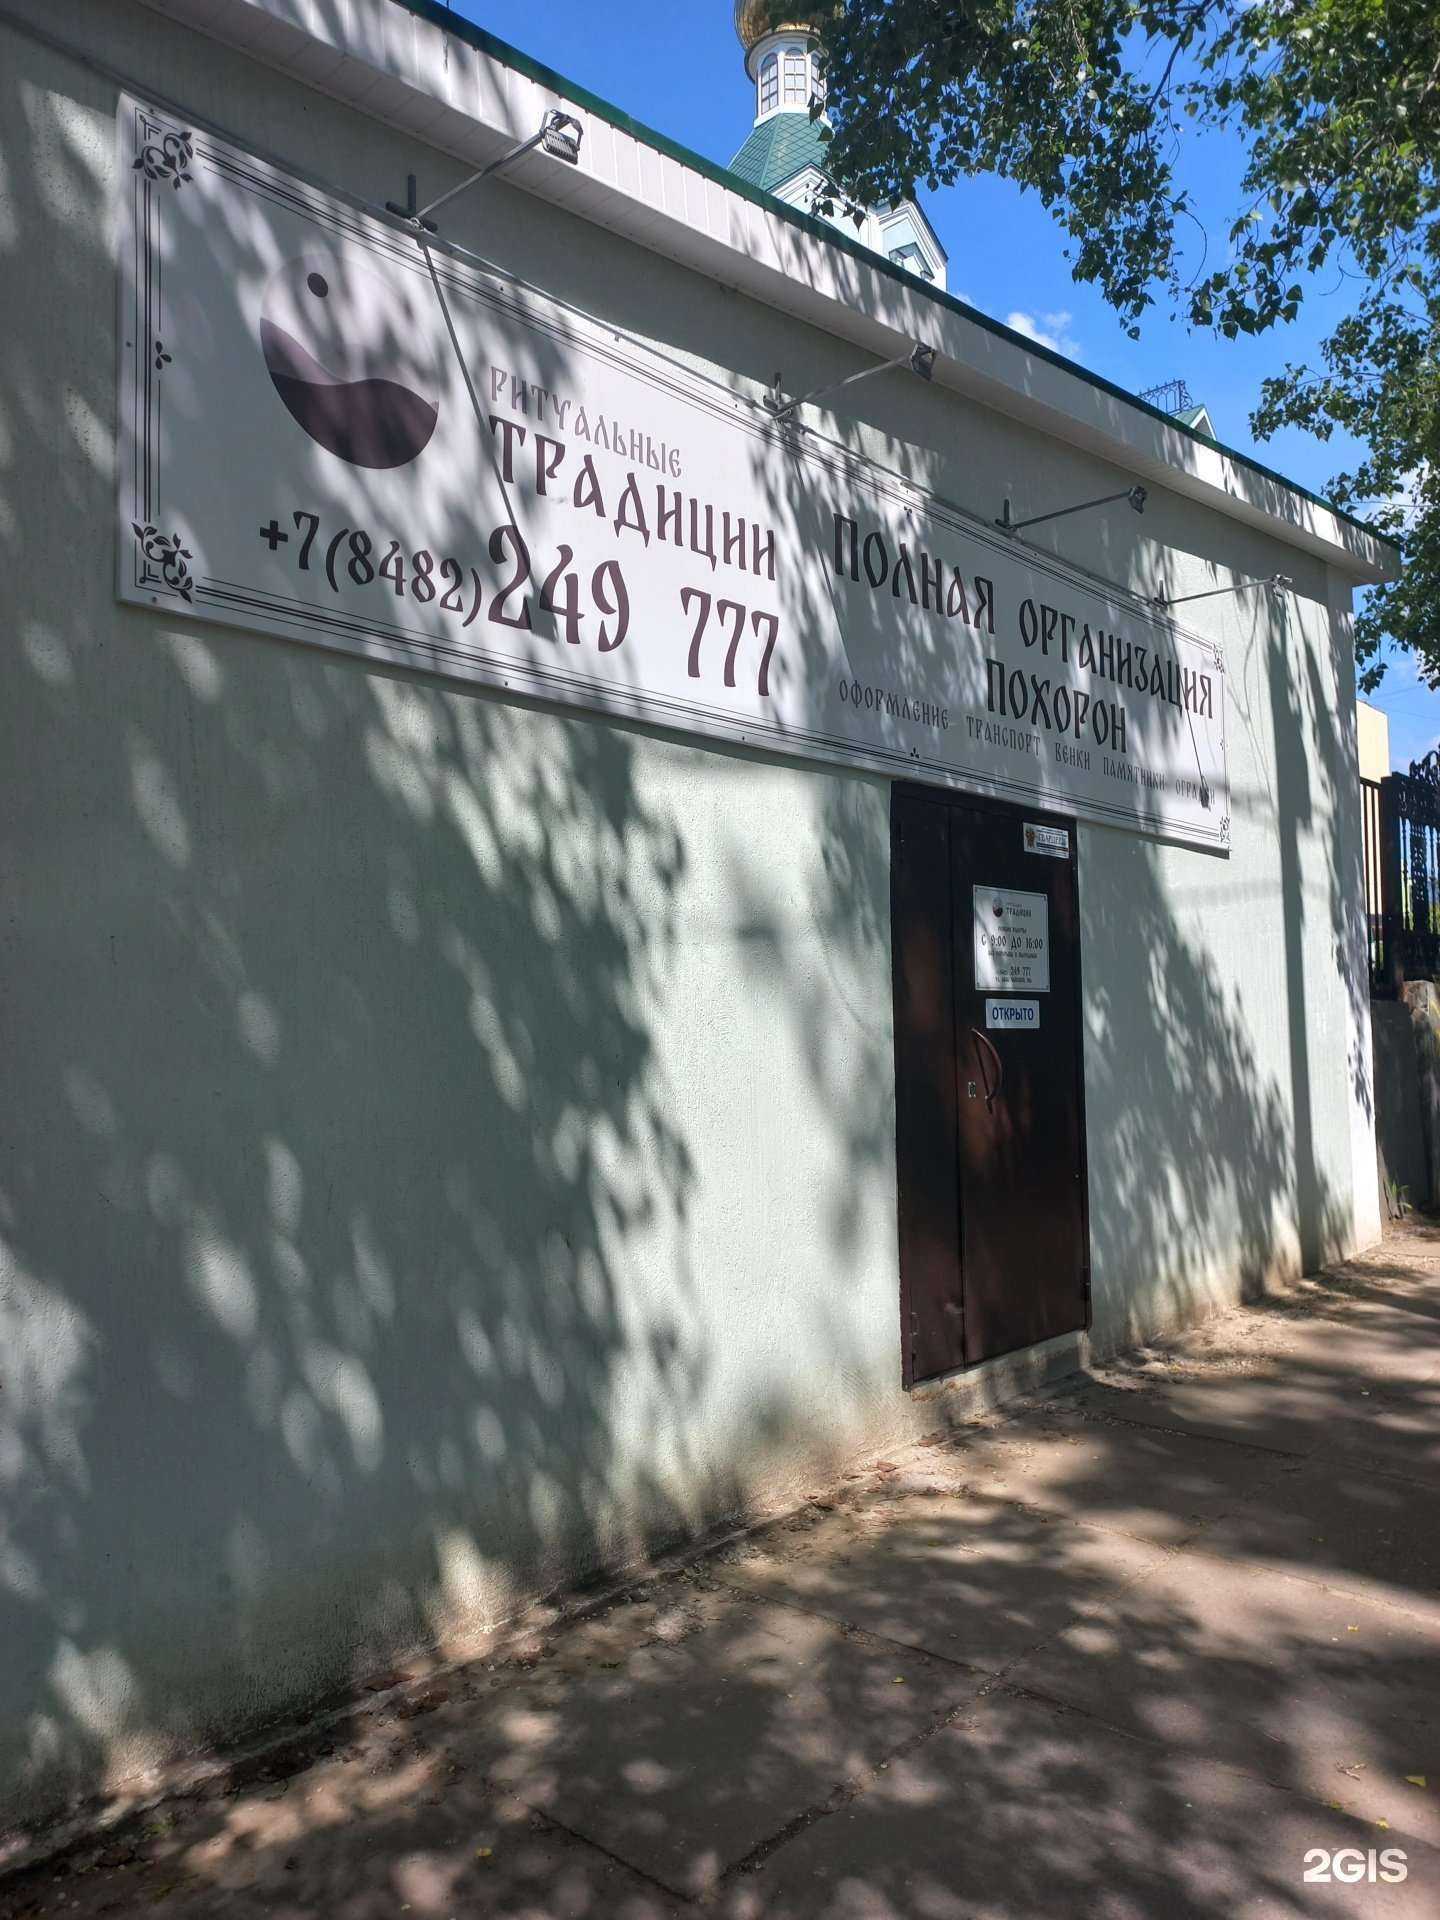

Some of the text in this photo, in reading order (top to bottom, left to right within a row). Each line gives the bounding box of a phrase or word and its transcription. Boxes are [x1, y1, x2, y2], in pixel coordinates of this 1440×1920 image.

[490, 366, 682, 478] РИТУАЛЬНЫЕ
[488, 414, 777, 581] ТРАДИЦИИ
[680, 586, 780, 697] 777
[833, 512, 1213, 719] ПОЛНАЯ ОРГАНИЗАЦИЯ
[838, 679, 950, 730] ОФОРМЛЕНИЕ
[965, 714, 1041, 760] ТРАНСПОРТ
[1055, 742, 1091, 771] ВЕНКИ
[1103, 756, 1166, 791] ПАМЯТНИКИ
[985, 657, 1128, 754] ПОХОРОН
[1010, 935, 1022, 950] ДО
[992, 1007, 1034, 1020] ОТКРЫТО
